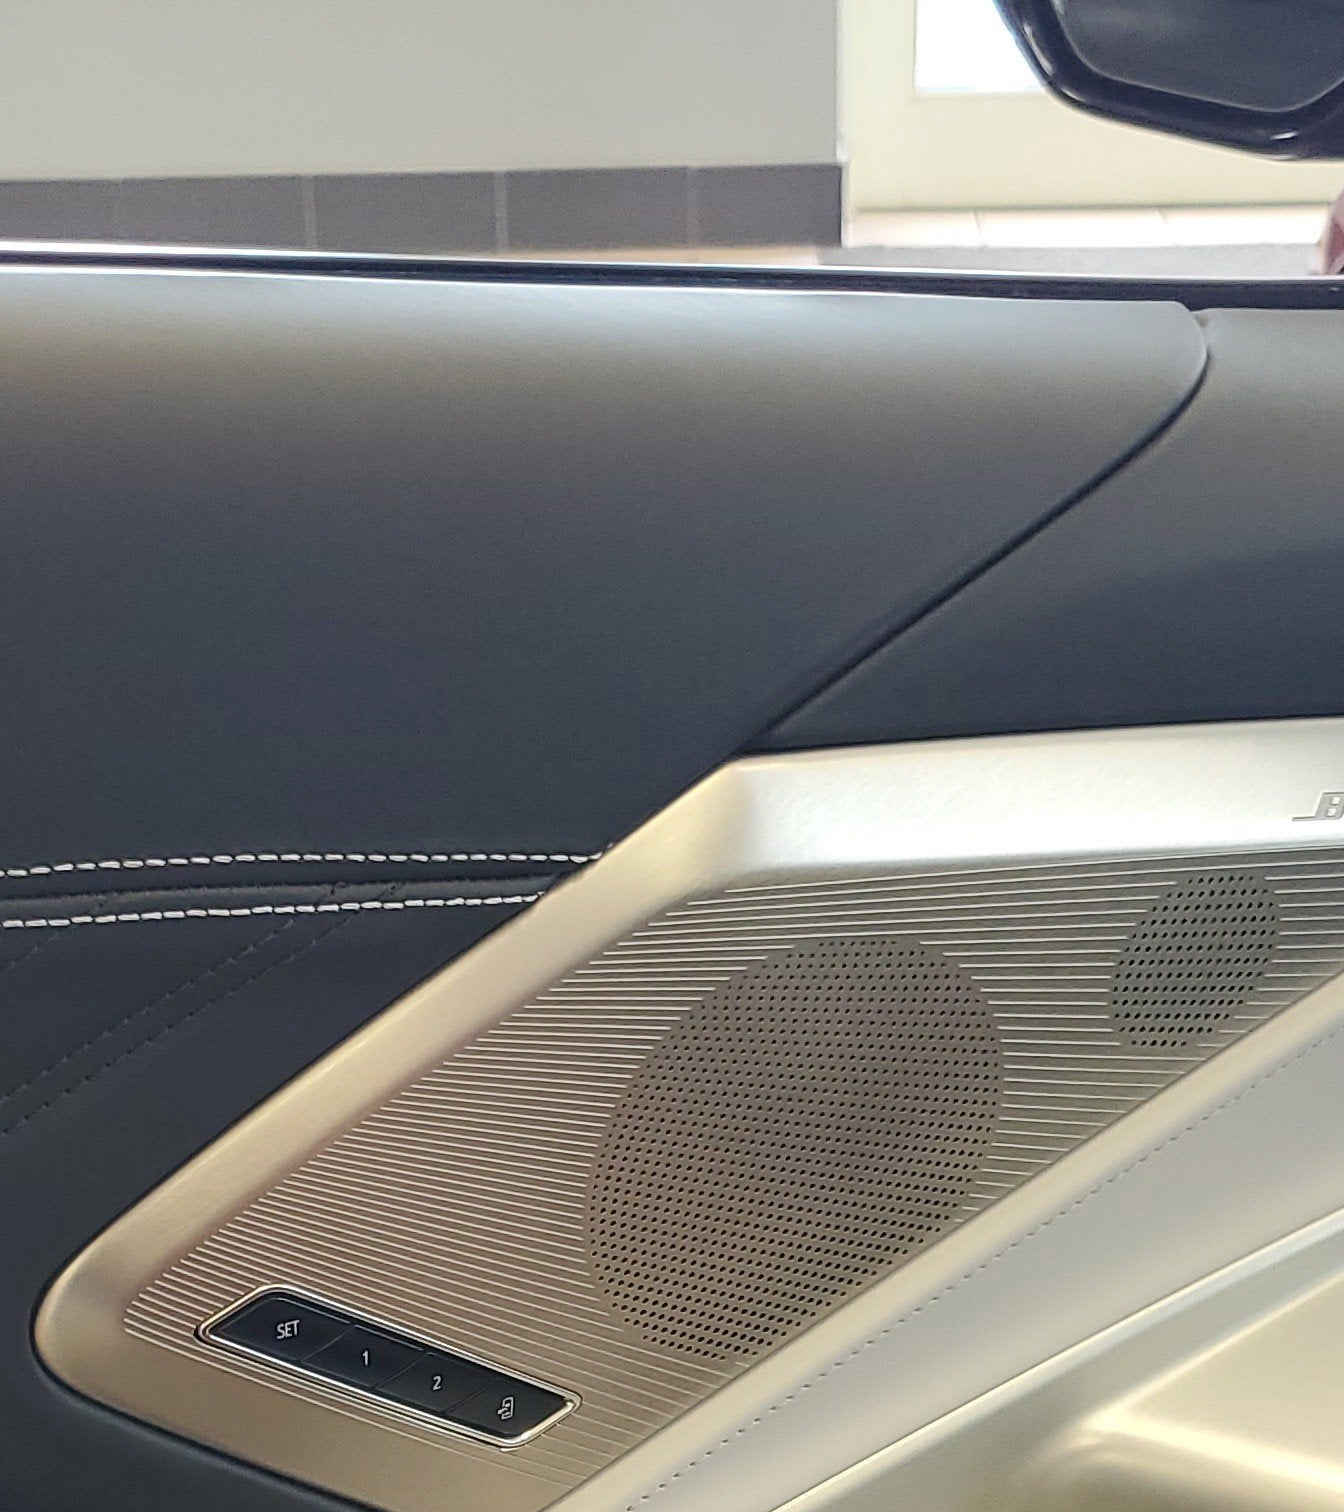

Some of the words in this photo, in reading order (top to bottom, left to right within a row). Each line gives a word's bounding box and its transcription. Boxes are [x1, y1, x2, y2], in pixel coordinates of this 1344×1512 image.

[276, 1320, 301, 1340] SET
[362, 1350, 370, 1366] 1
[432, 1375, 443, 1391] 2
